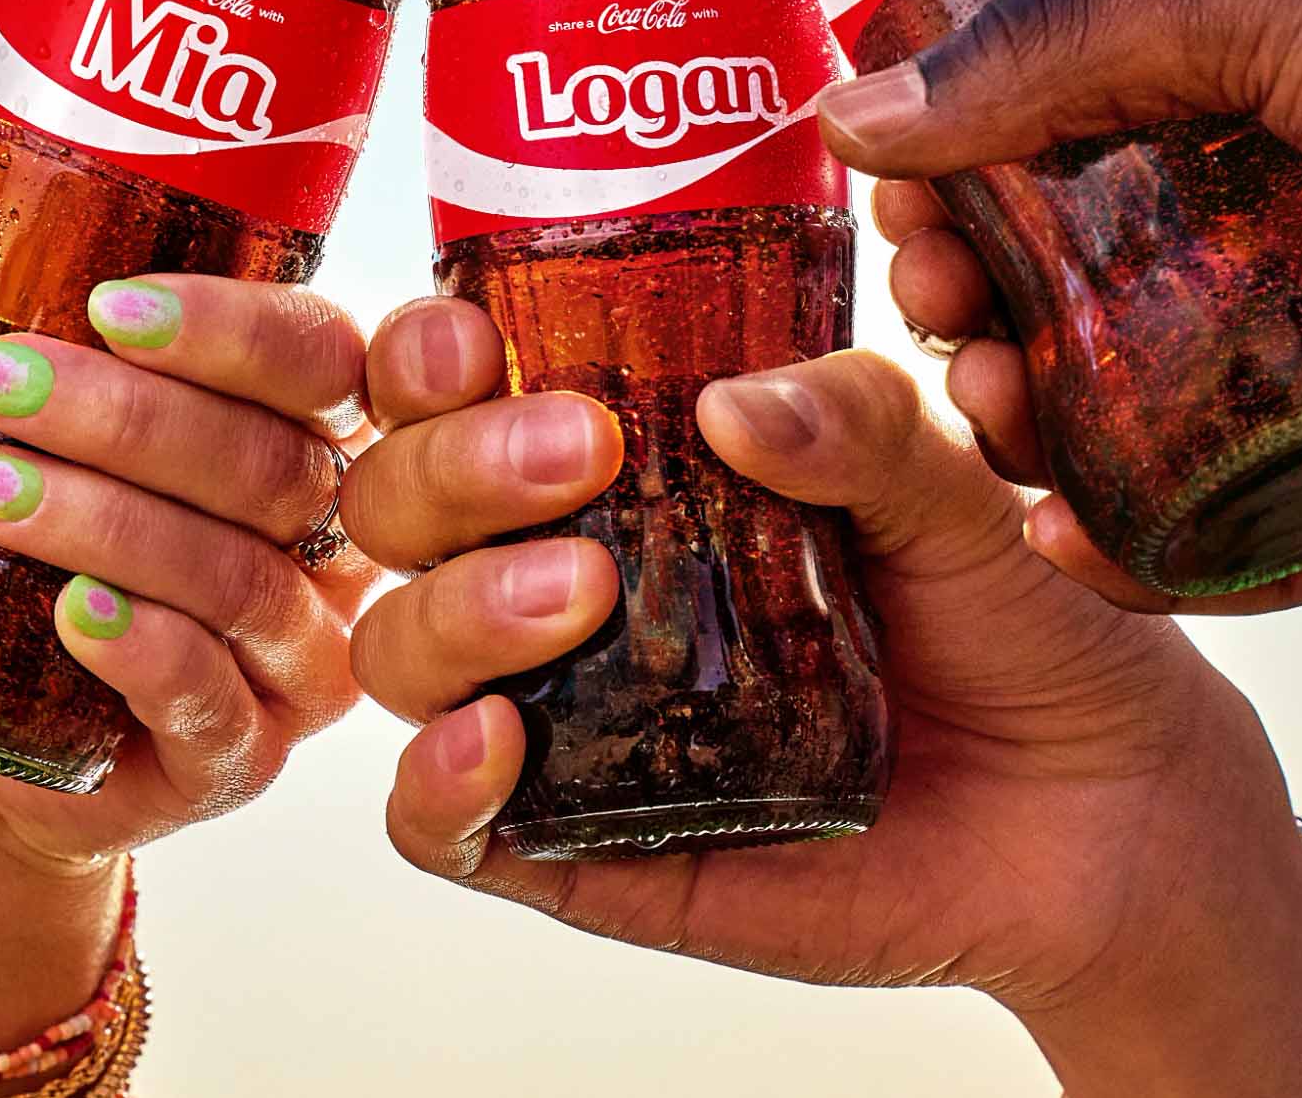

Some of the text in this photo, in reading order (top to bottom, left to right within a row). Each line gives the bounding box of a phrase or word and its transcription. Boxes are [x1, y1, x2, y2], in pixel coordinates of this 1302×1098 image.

[258, 8, 285, 24] with
[548, 20, 584, 33] share
[586, 20, 595, 29] a
[692, 8, 719, 19] with
[506, 51, 788, 149] Logan
